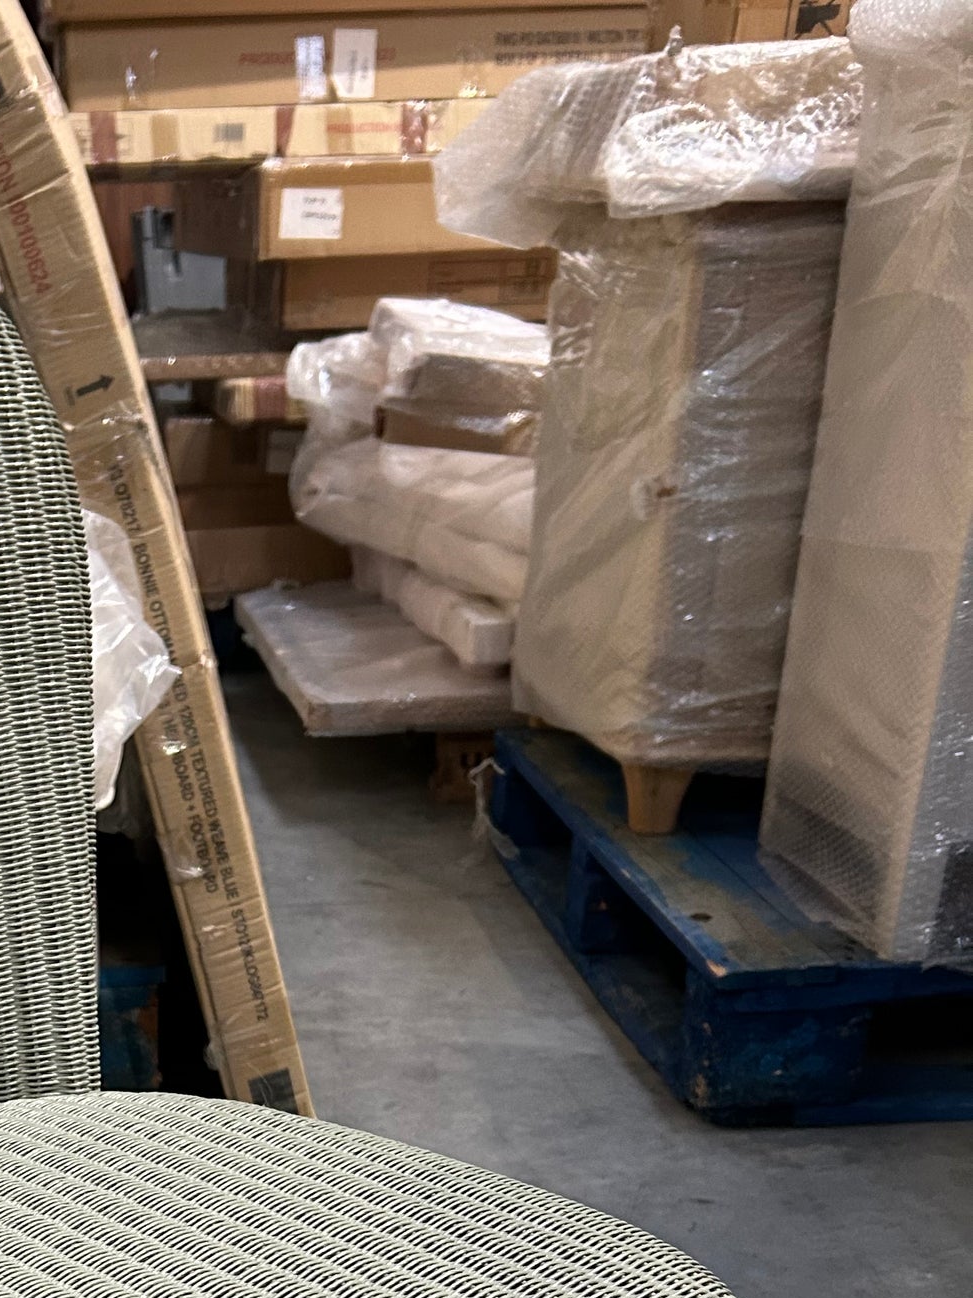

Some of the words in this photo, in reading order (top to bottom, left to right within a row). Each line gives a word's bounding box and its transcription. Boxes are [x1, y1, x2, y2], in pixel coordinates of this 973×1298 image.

[133, 543, 159, 598] BONNIE
[178, 705, 201, 748] 120CM
[190, 749, 218, 818] TEXTURED
[208, 817, 230, 865] WEAVE
[220, 863, 240, 899] BLUE
[164, 718, 195, 802] HEBOARD
